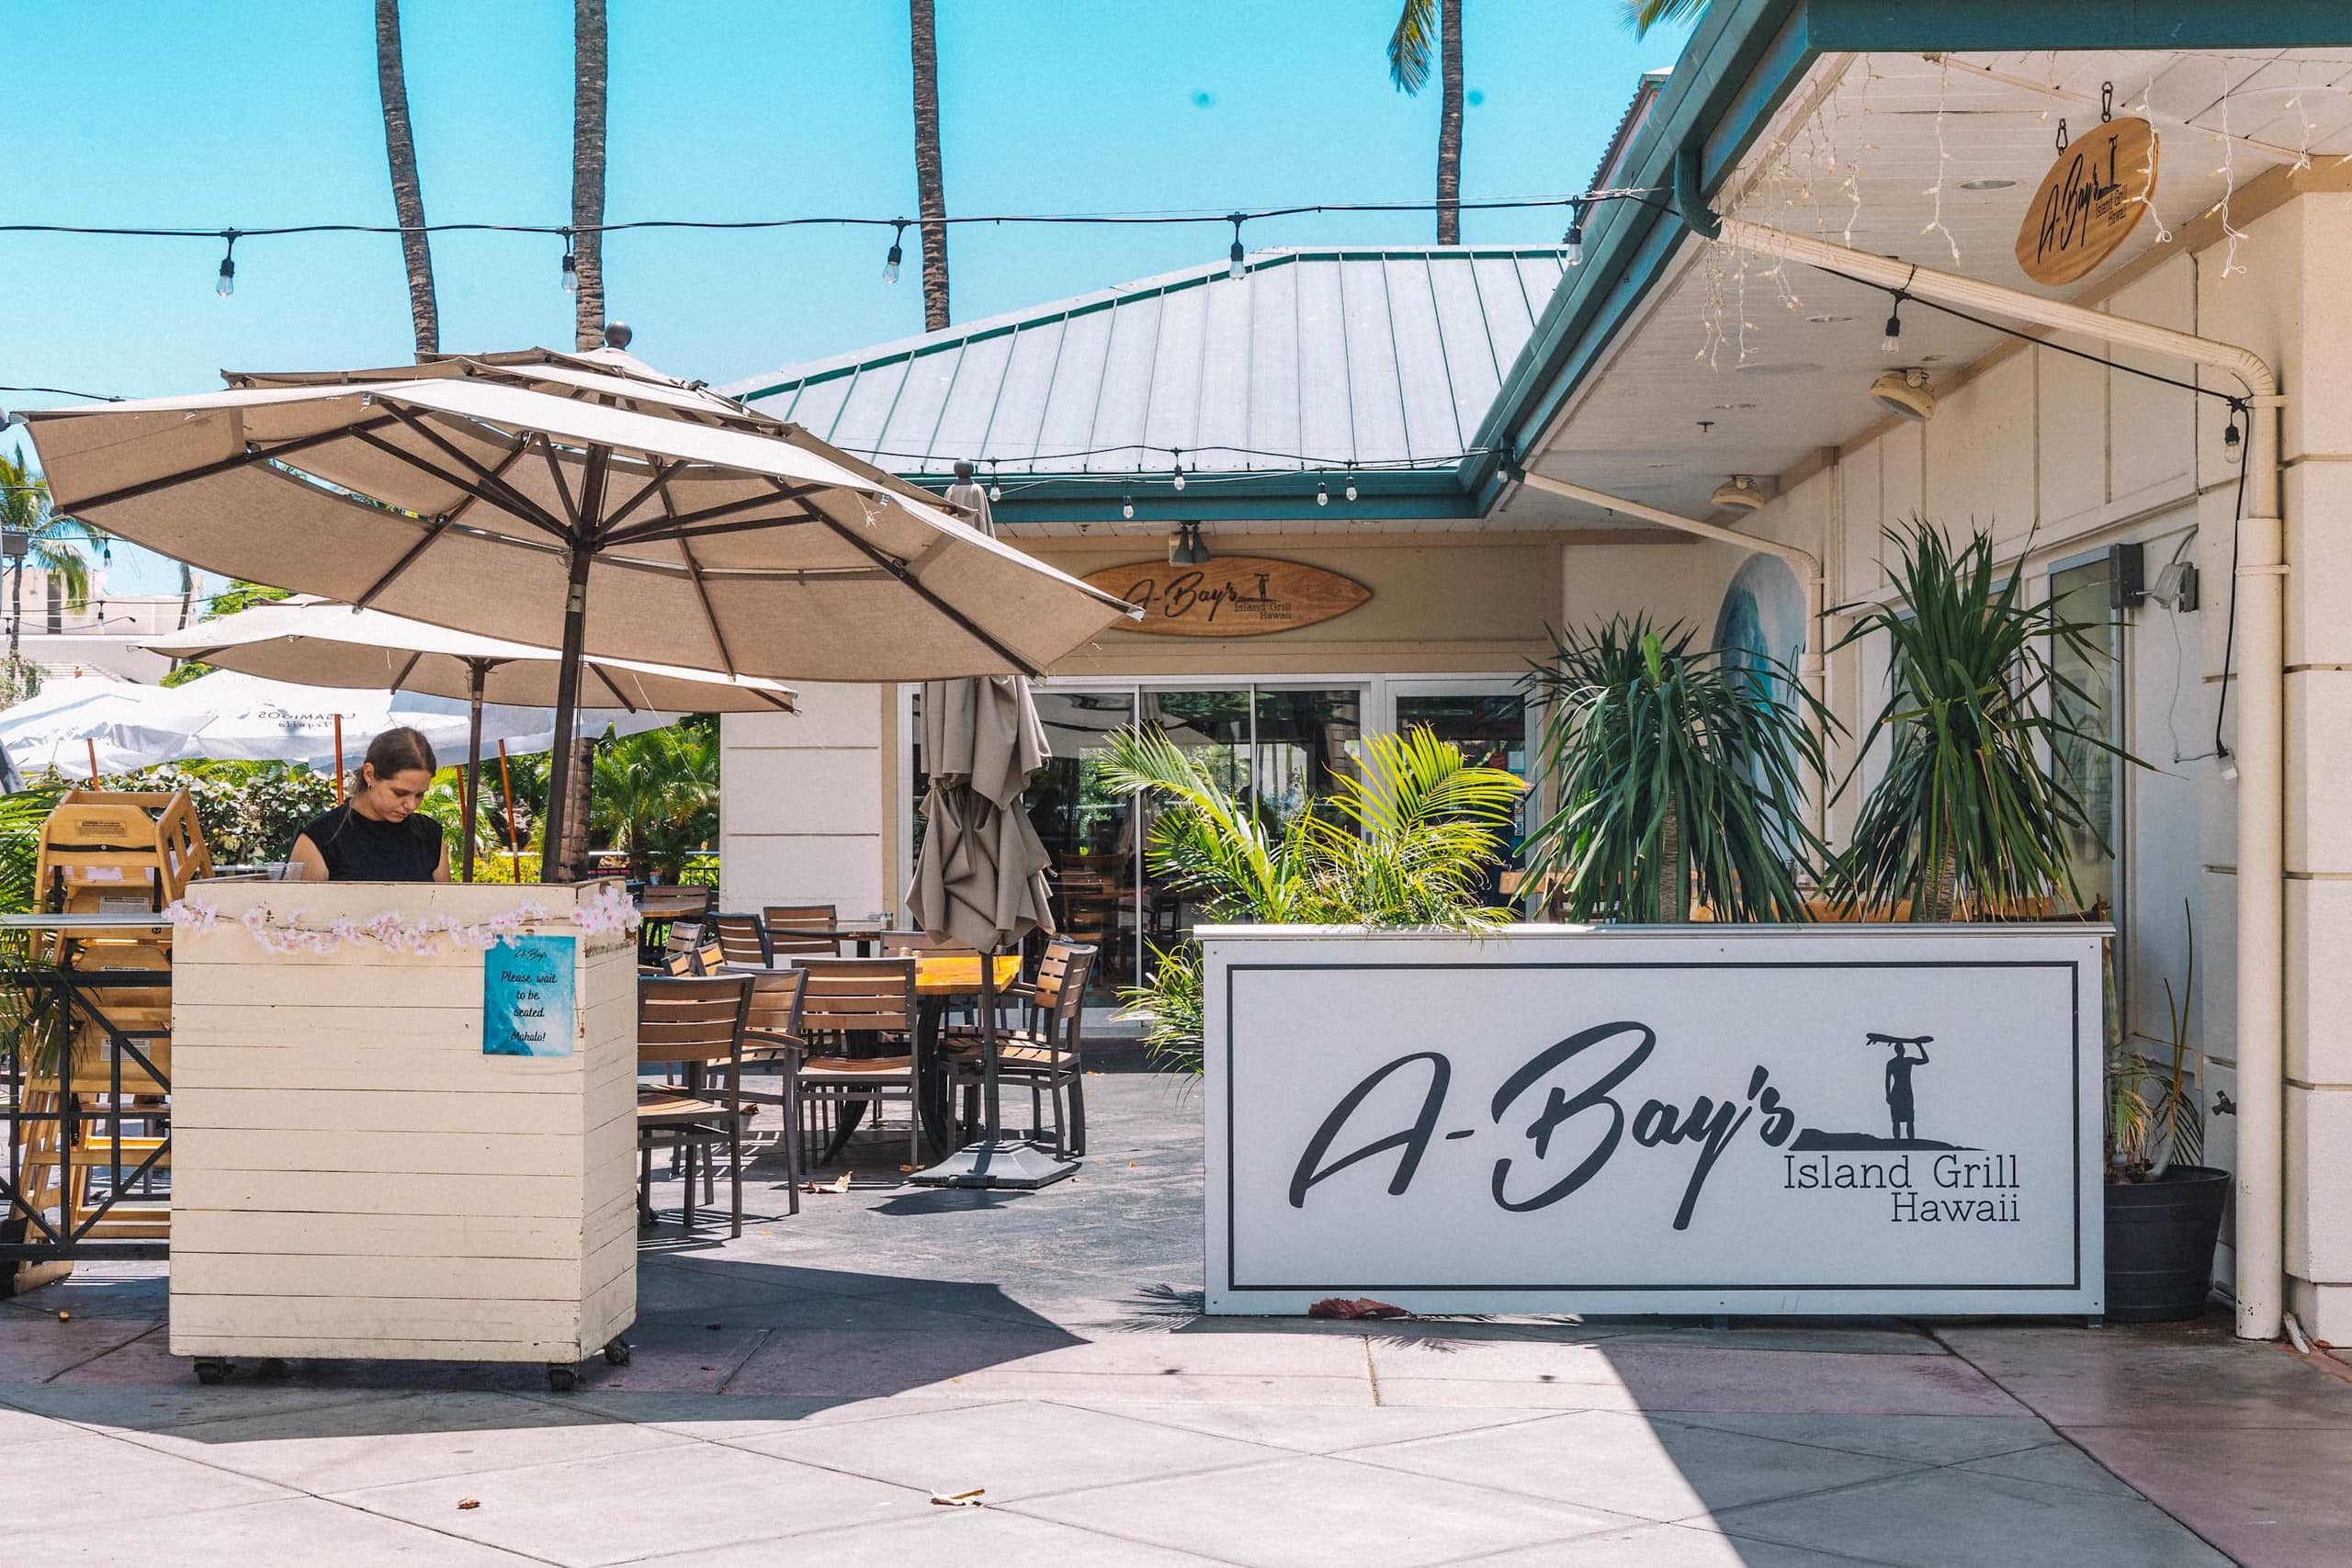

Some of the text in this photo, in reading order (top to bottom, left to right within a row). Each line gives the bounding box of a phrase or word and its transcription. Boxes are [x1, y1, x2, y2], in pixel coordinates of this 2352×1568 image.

[1234, 602, 1292, 613] Island Grill
[1260, 611, 1292, 620] Hawaii
[500, 971, 558, 984] Please wait
[516, 990, 540, 1000] to be
[514, 1007, 545, 1018] seated
[510, 1030, 546, 1042] Mahalo!
[1289, 1021, 1795, 1231] A-Bay's
[1783, 1154, 2020, 1190] Island Grill
[1890, 1191, 2021, 1224] Hawaii
